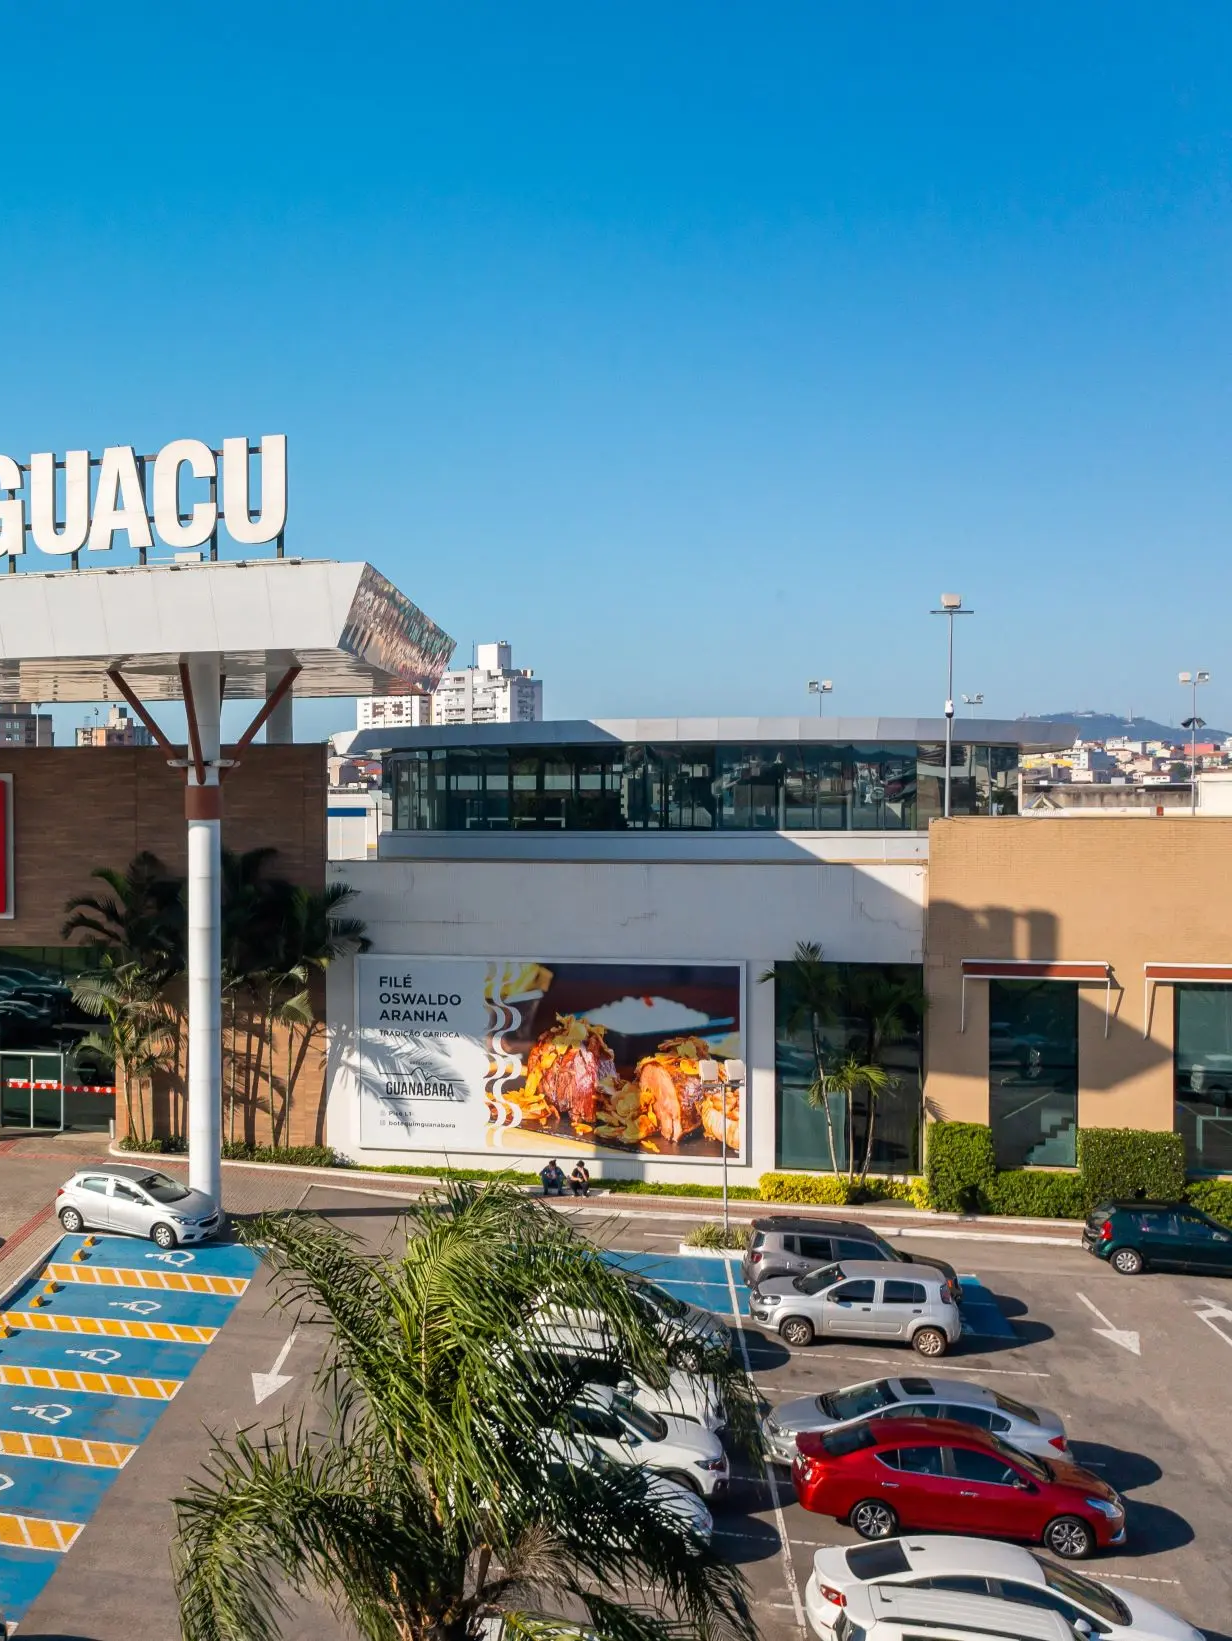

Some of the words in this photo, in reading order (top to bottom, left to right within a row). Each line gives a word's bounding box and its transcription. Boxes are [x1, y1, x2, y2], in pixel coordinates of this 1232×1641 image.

[379, 973, 413, 988] FILÉ
[379, 992, 462, 1006] OSWALDO
[379, 1009, 449, 1023] ARANHA
[379, 1029, 421, 1039] TRADIÇÃO
[422, 1031, 460, 1039] CARIOCA
[386, 1081, 455, 1097] GUANABARA
